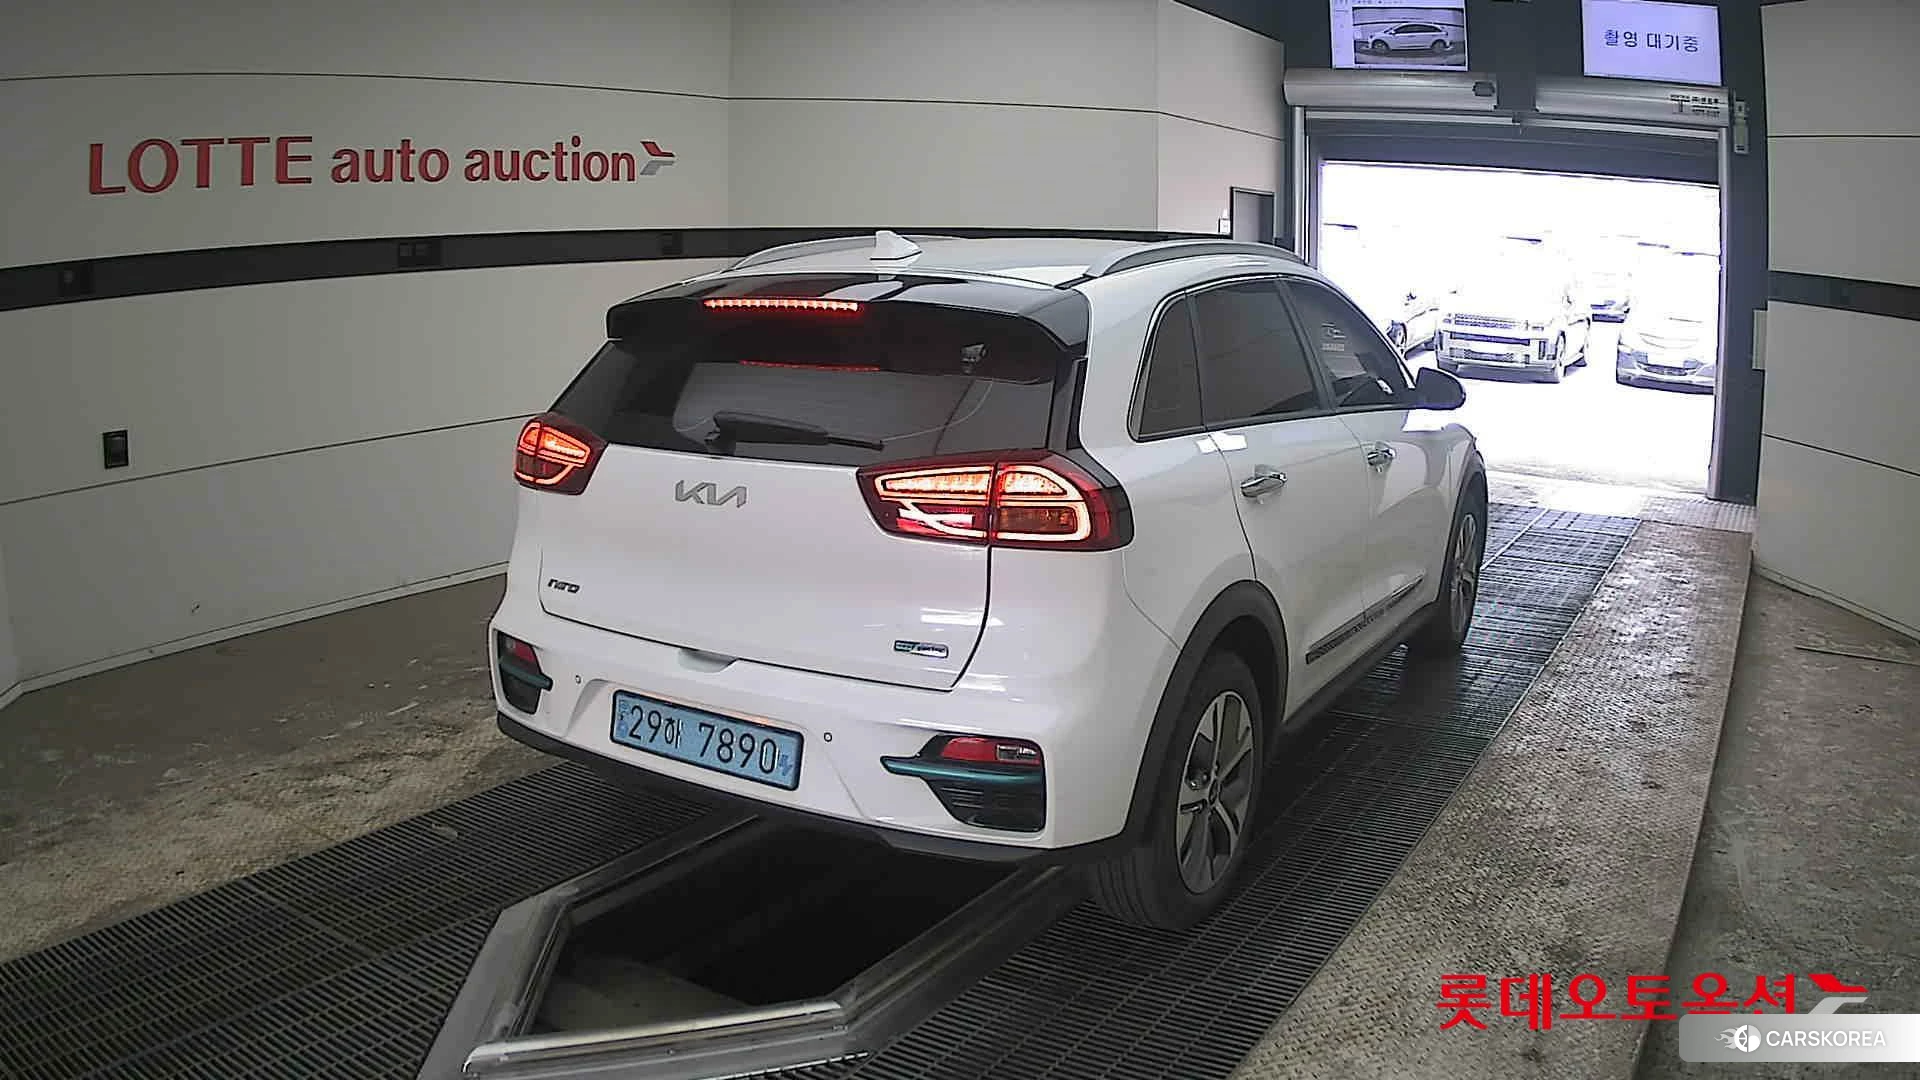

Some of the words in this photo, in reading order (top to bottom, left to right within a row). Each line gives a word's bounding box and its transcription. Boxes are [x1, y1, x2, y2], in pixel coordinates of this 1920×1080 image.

[1605, 29, 1638, 48] 촬영
[1646, 32, 1698, 53] 대기중
[89, 135, 313, 195] LOTTE
[330, 138, 450, 184] auto
[463, 135, 636, 183] auction
[698, 721, 779, 775] 7890
